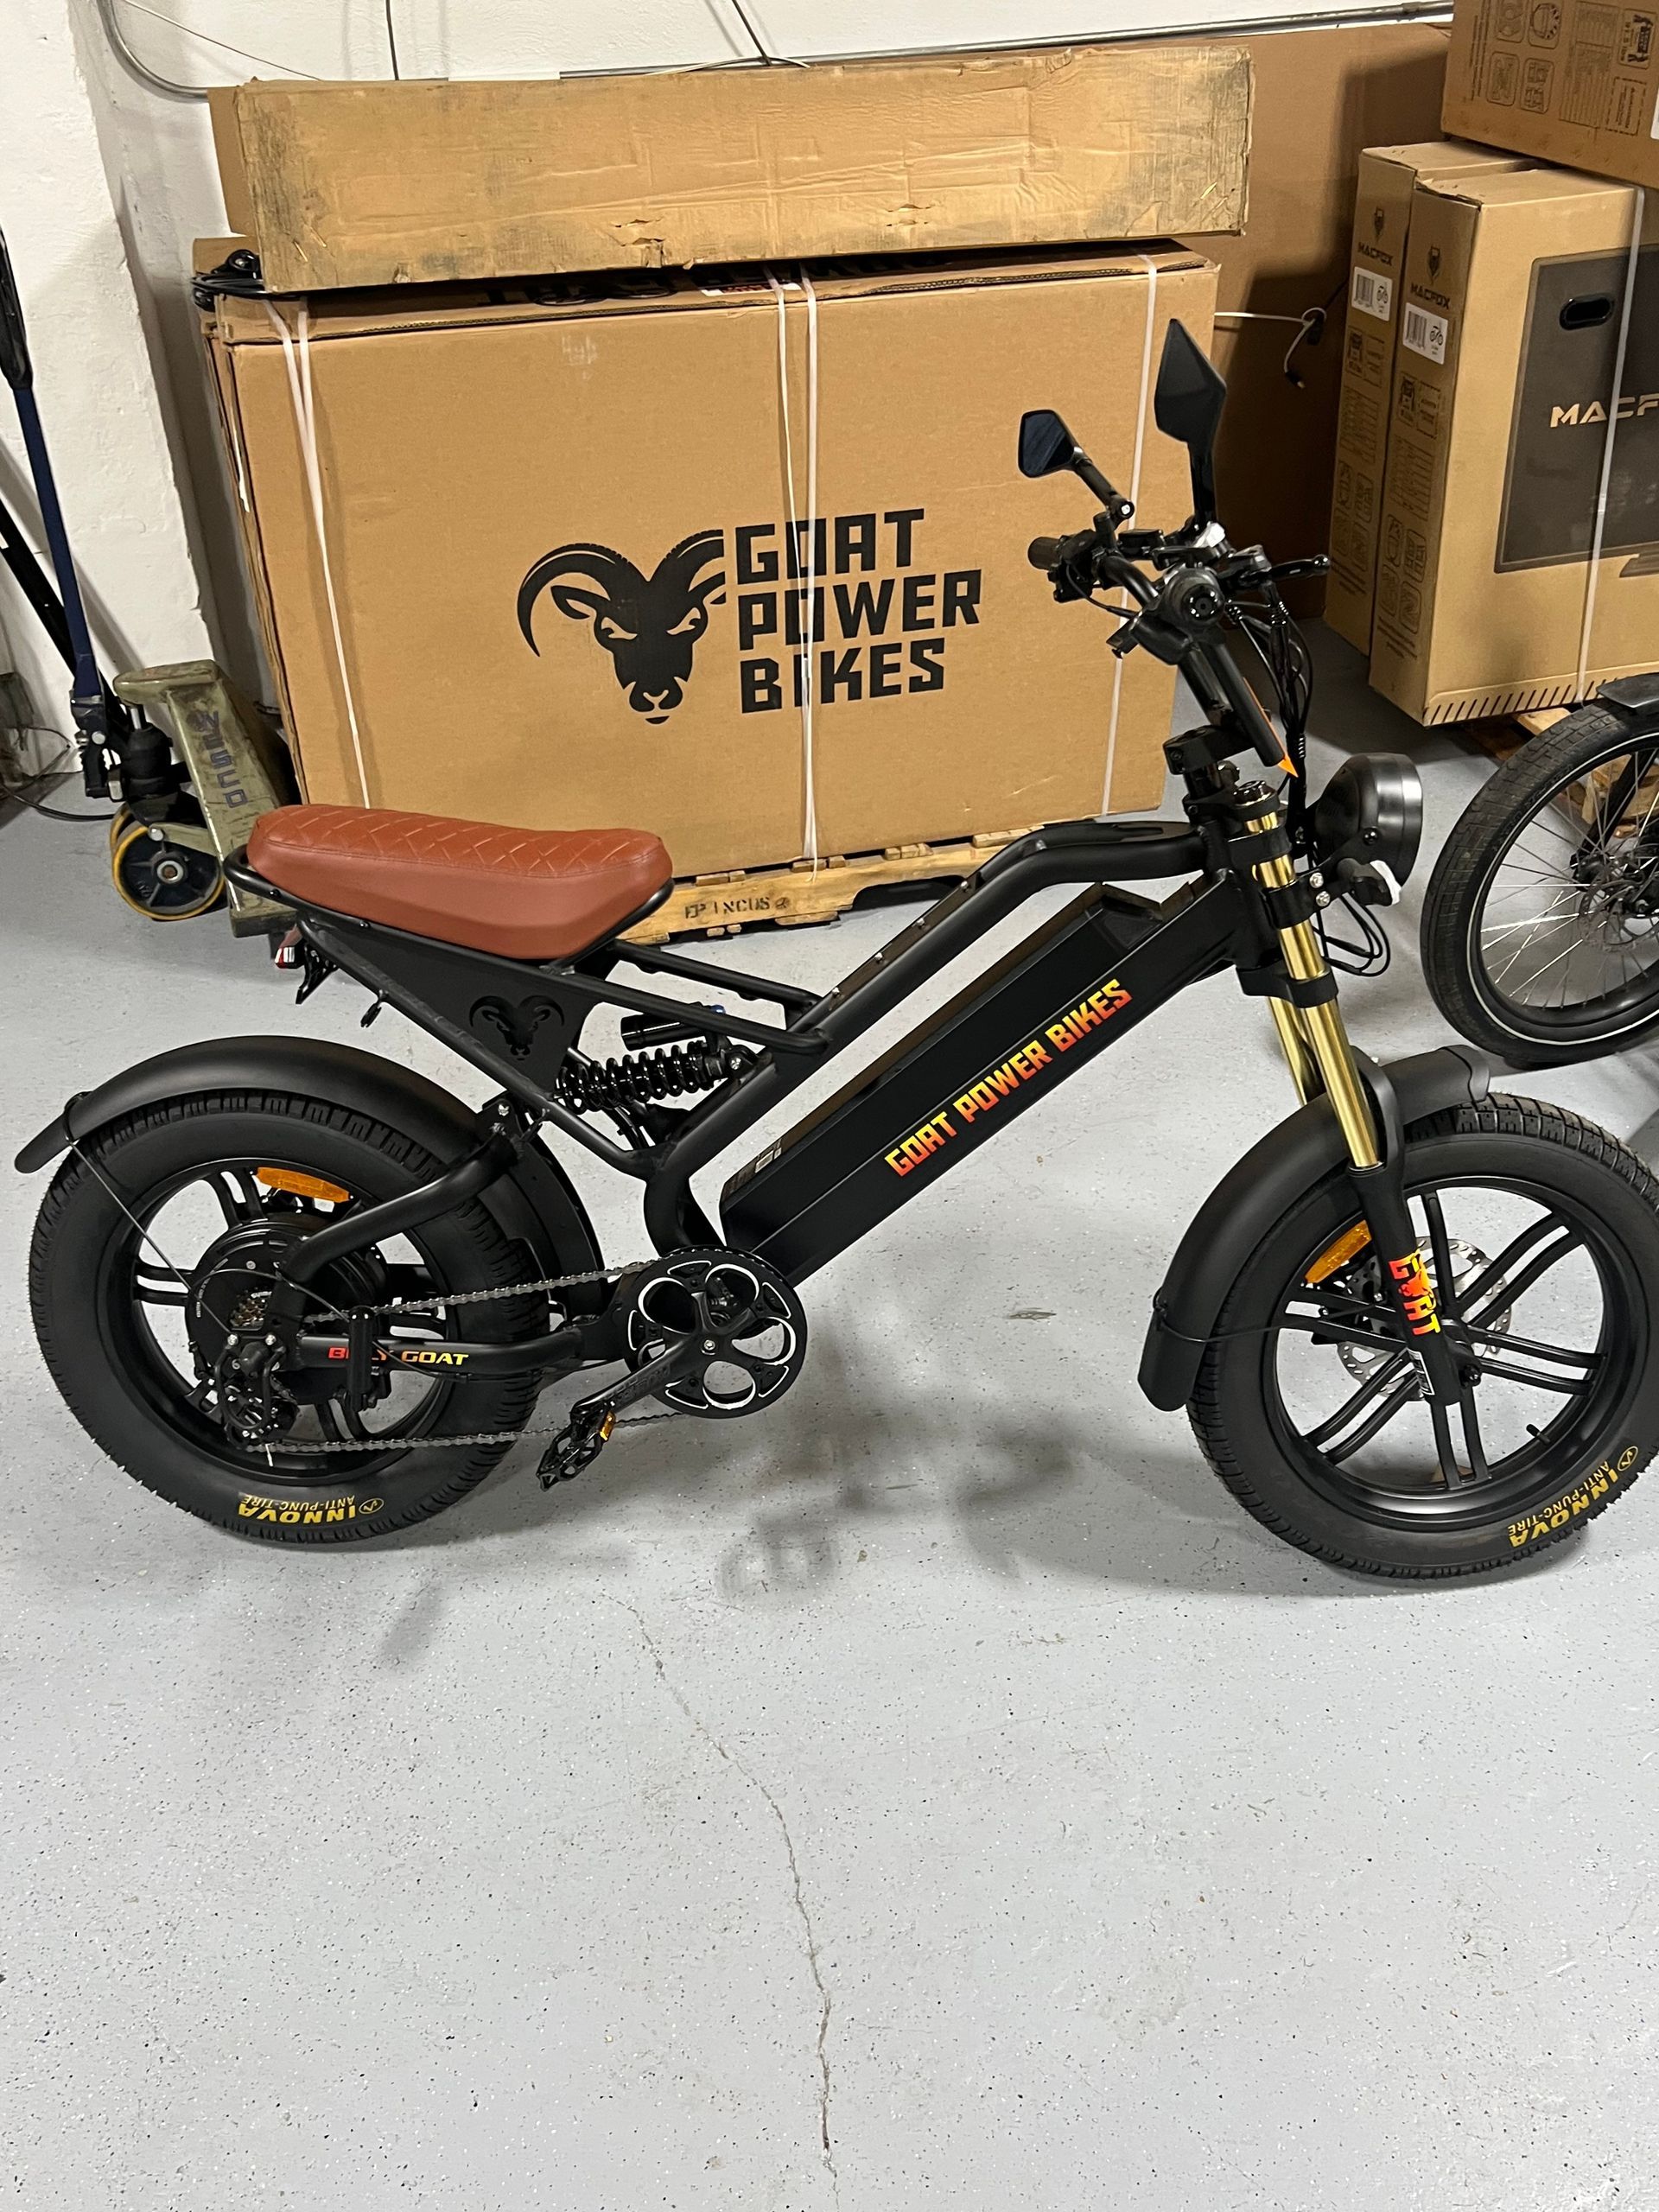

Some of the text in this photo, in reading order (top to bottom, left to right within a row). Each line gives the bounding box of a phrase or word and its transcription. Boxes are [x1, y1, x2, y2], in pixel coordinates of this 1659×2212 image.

[1410, 283, 1452, 310] MACFOX
[734, 508, 925, 585] GOAT
[738, 569, 982, 651] POWER
[740, 637, 945, 714] BIKES
[884, 978, 1134, 1177] GOAT POWER BIKES
[401, 1351, 469, 1365] GOAT
[238, 1503, 356, 1524] INNOVA
[243, 1494, 356, 1512] ANTI-PUNC-TIRE
[1508, 1461, 1610, 1535] ANTI-PUNC-TIRE
[1509, 1469, 1618, 1548] INNOVA
